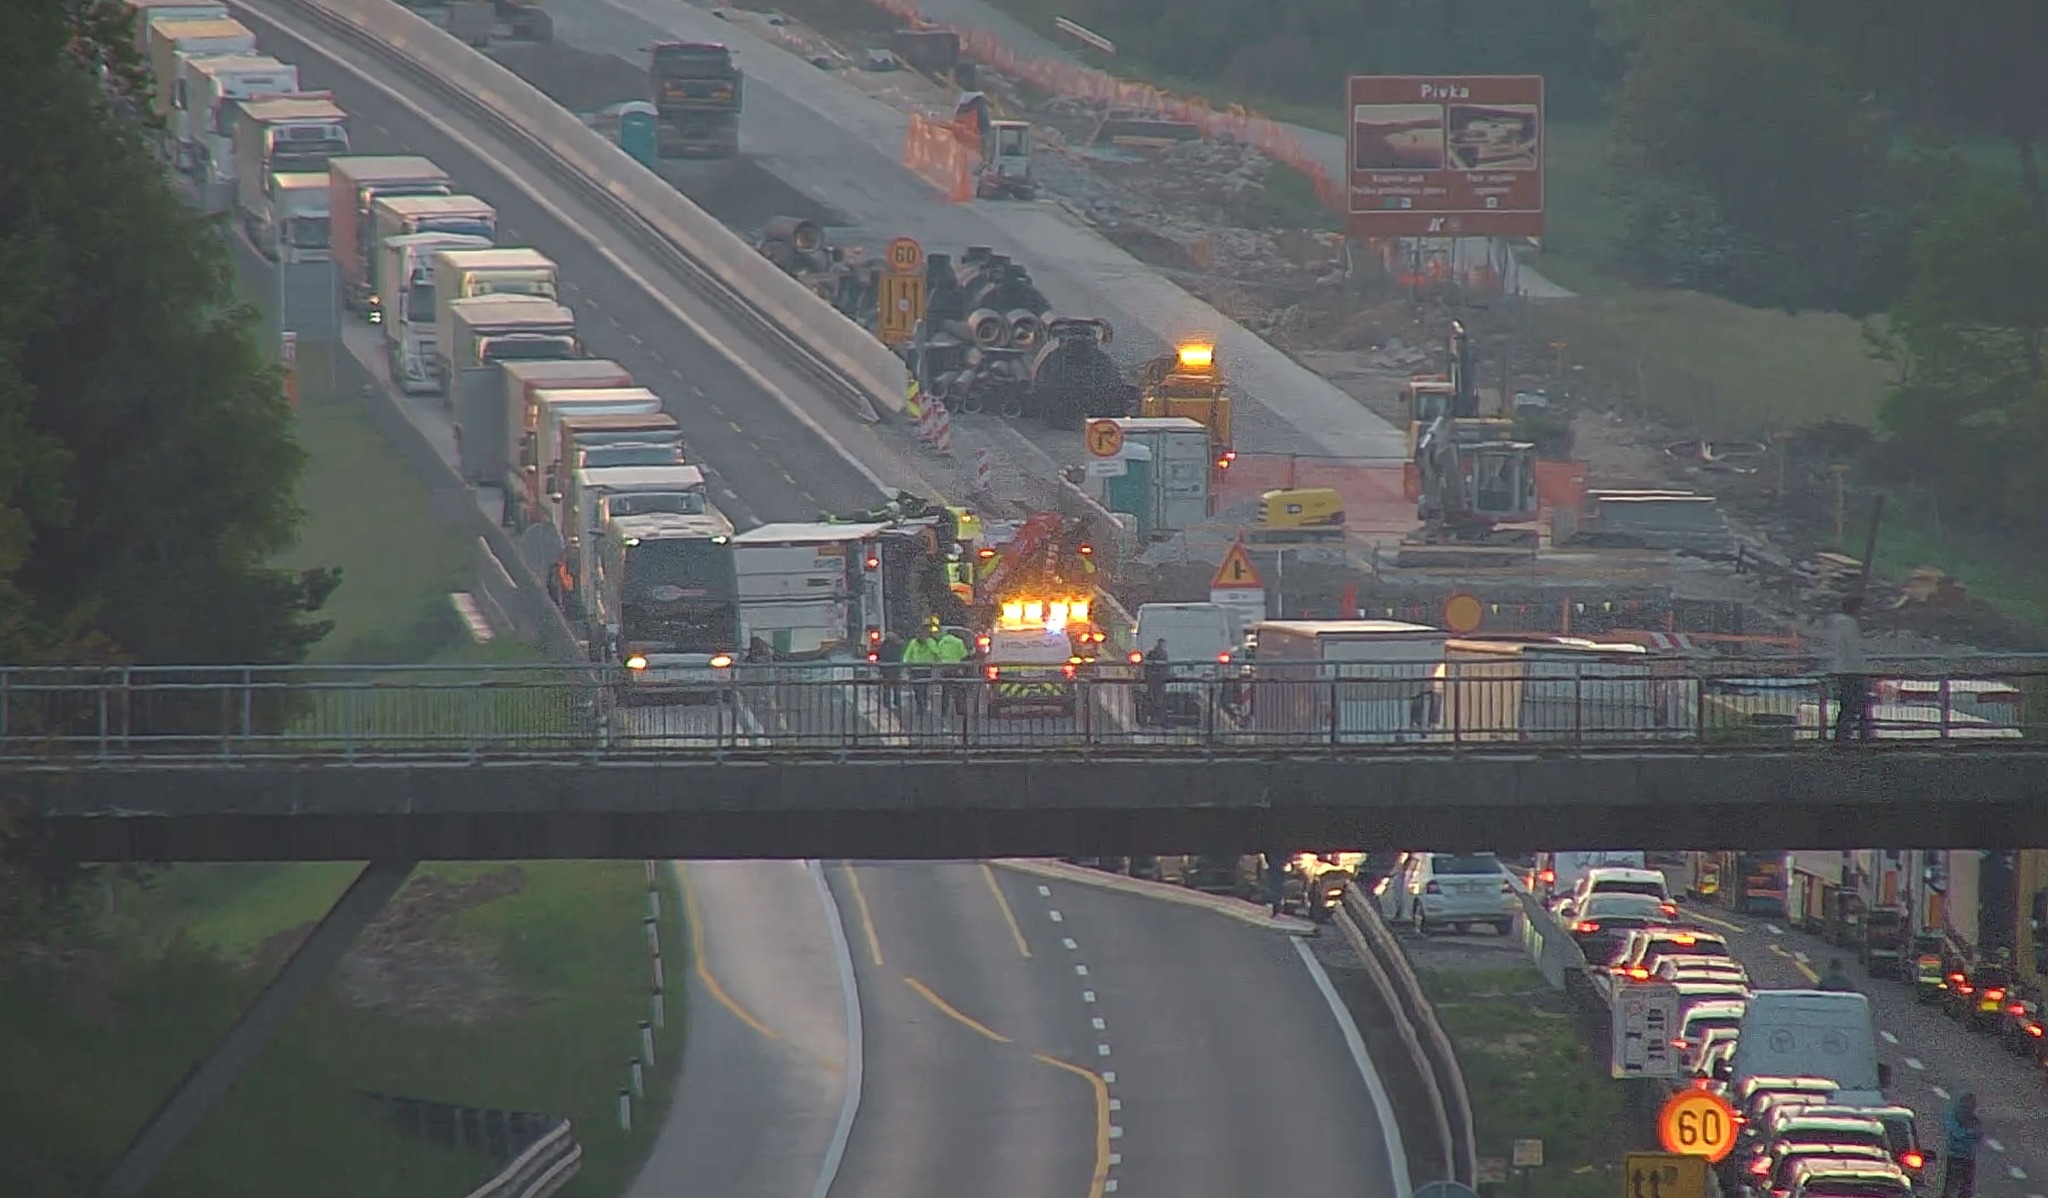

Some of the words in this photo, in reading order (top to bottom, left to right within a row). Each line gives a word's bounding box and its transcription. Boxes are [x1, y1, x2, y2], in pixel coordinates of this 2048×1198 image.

[1421, 84, 1470, 98] Pivka
[895, 245, 916, 264] 60
[1678, 1109, 1721, 1146] 60
